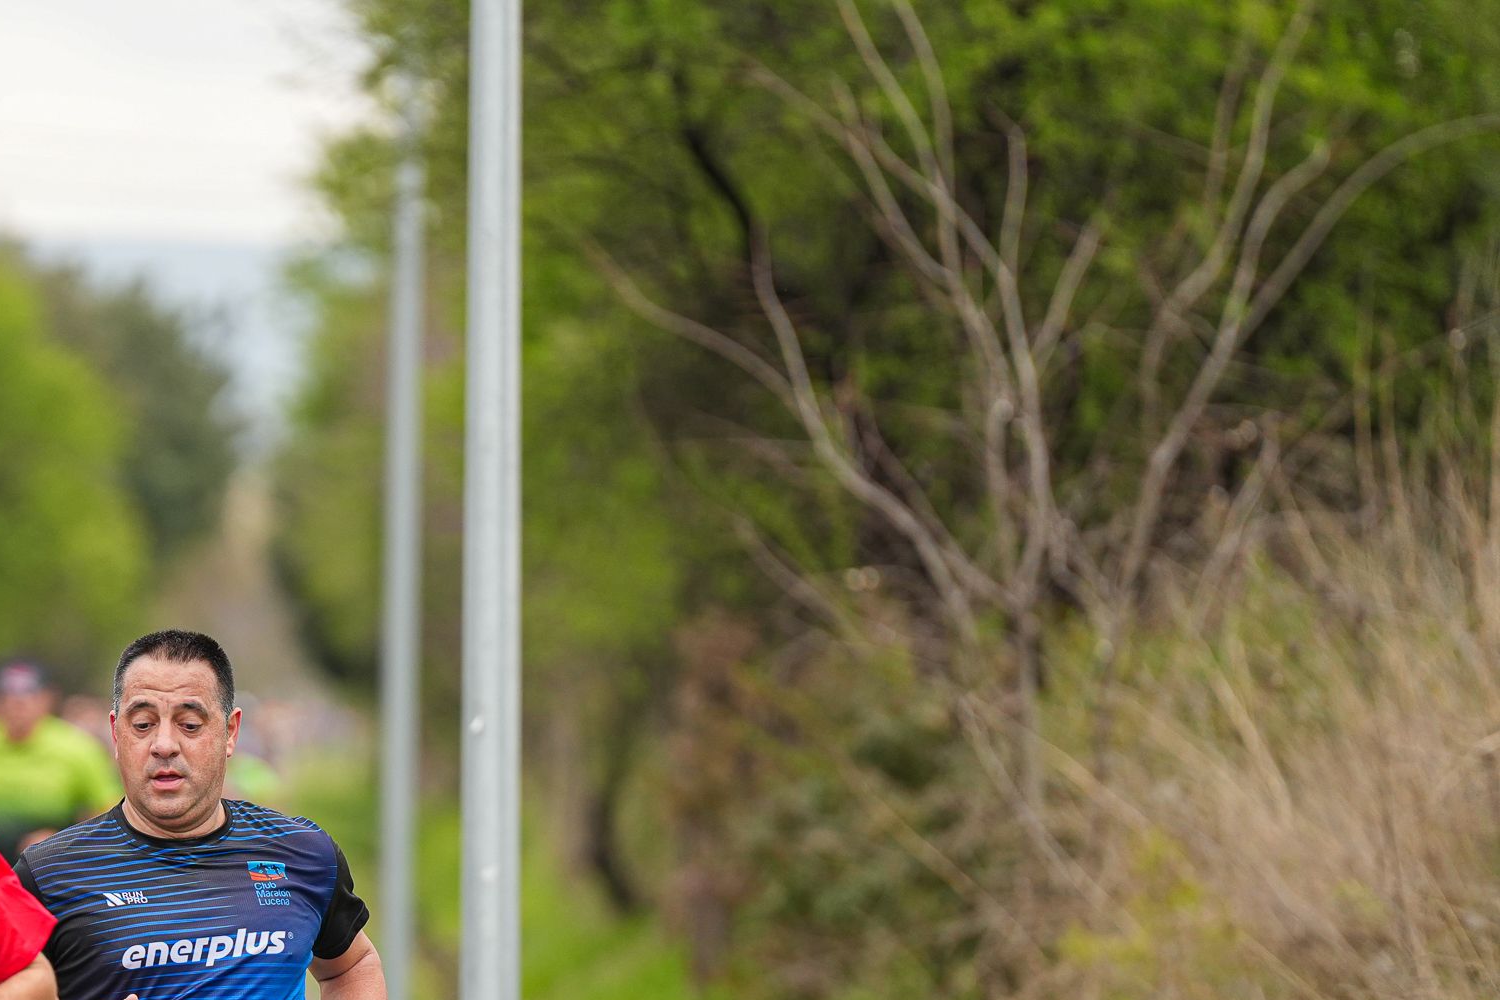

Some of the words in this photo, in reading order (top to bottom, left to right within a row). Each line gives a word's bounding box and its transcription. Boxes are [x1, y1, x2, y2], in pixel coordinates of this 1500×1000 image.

[254, 881, 277, 890] Club
[121, 891, 144, 900] RUN
[127, 896, 149, 905] PRO
[258, 898, 290, 906] Lucena
[121, 928, 287, 969] enerplus
